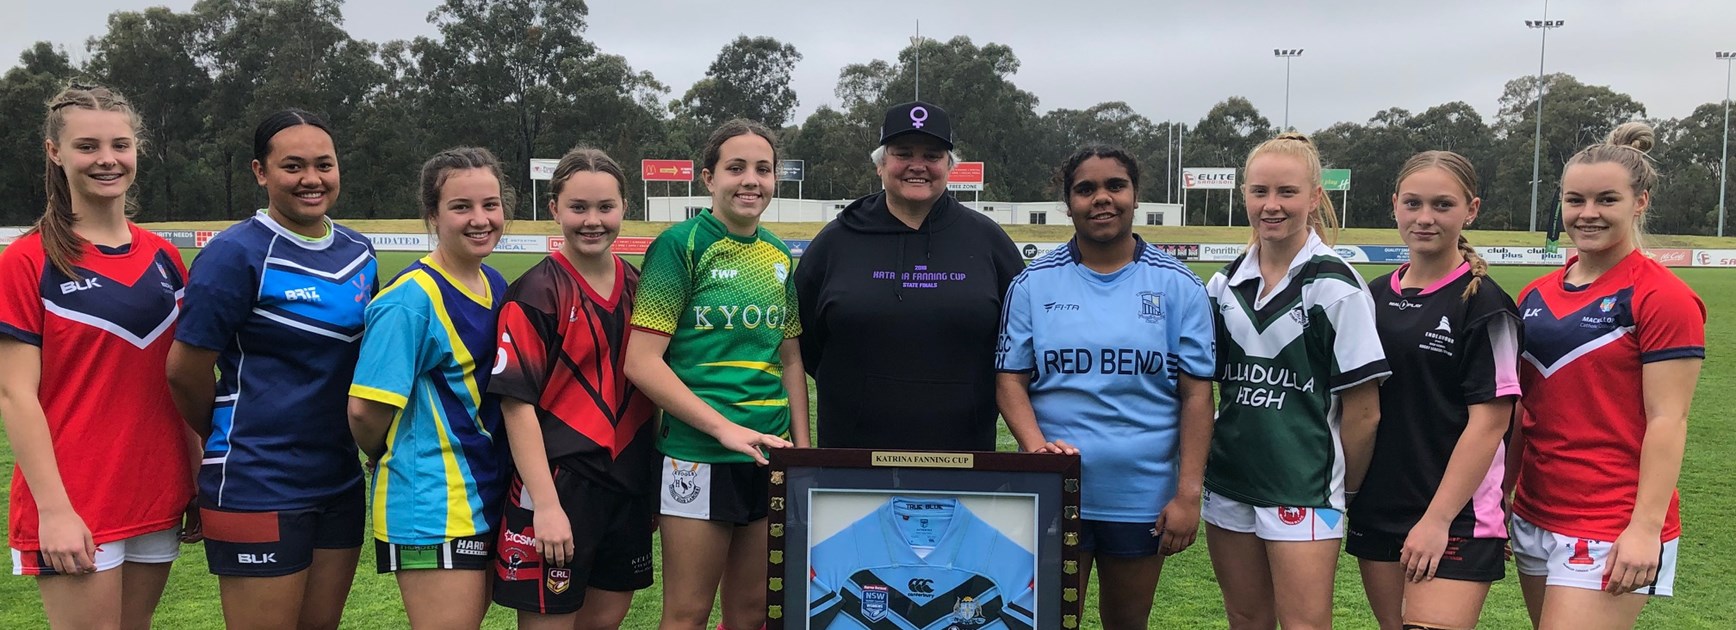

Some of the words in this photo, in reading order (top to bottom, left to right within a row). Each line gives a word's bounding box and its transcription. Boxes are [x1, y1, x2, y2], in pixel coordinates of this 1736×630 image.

[1198, 173, 1235, 181] ELITE
[1501, 252, 1523, 260] plus
[710, 269, 738, 279] TWP
[912, 272, 948, 281] FANNING
[949, 272, 966, 281] CUP
[59, 277, 103, 295] BLK
[1043, 348, 1093, 375] RED
[1100, 348, 1164, 376] BEND
[1235, 385, 1287, 410] HIGH
[875, 455, 913, 463] KATRINA
[914, 456, 951, 464] FANNING
[952, 456, 969, 464] CUP
[237, 552, 278, 564] BLK
[550, 569, 569, 578] CRL
[865, 592, 886, 600] NSW
